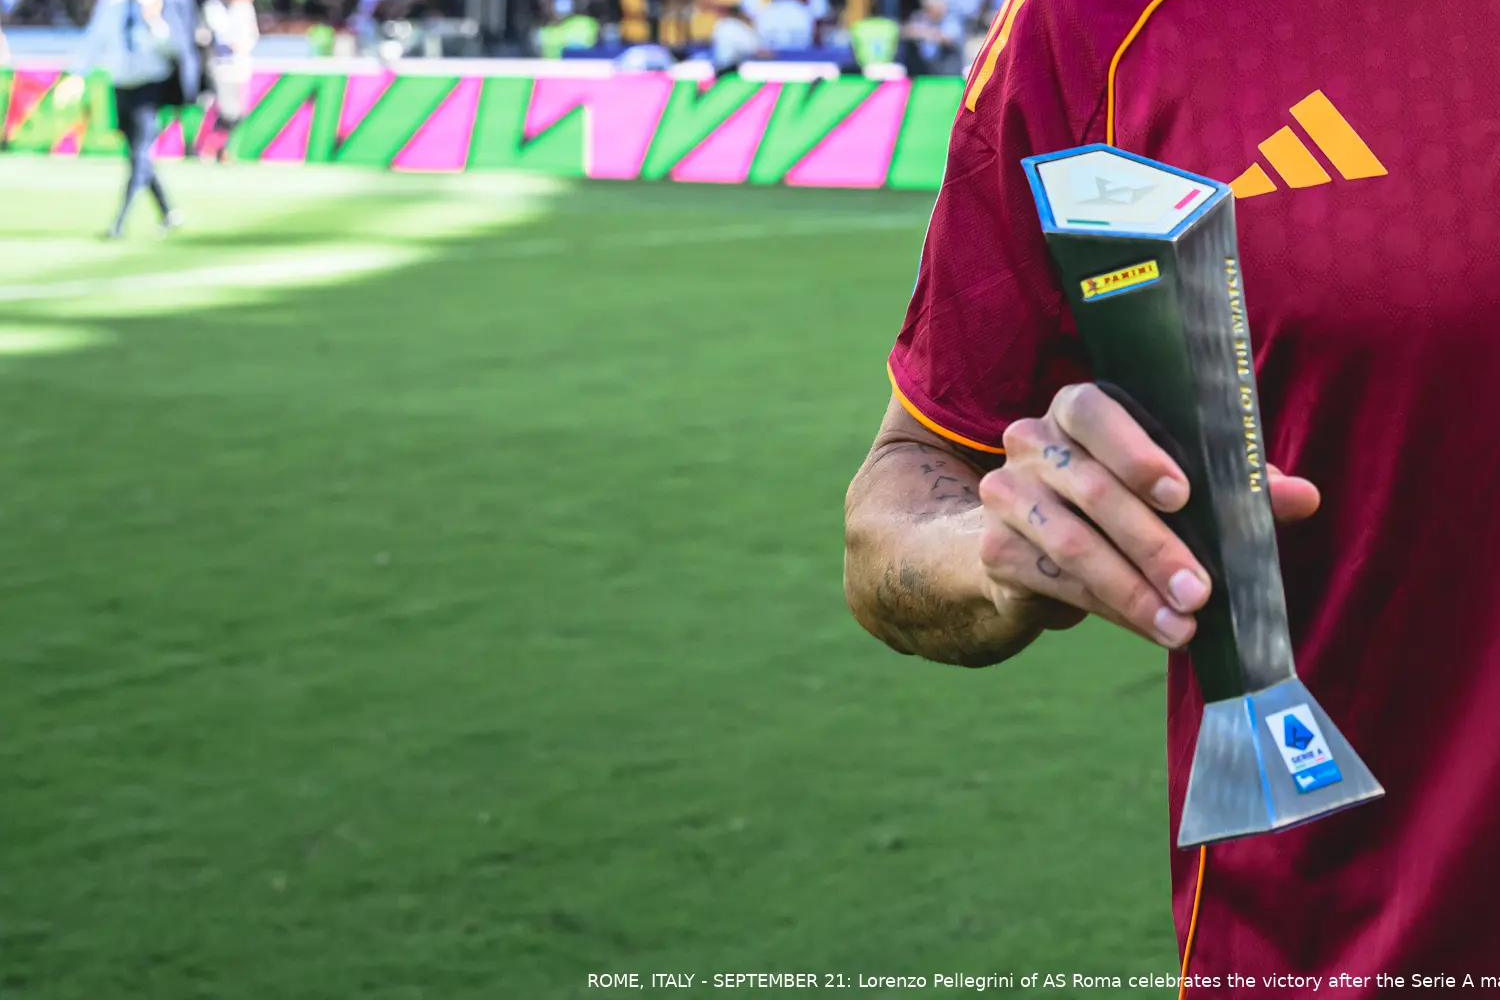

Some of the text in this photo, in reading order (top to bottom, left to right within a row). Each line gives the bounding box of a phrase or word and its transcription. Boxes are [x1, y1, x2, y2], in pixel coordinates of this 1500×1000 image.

[1104, 264, 1153, 284] PANINI
[1225, 257, 1244, 334] MATCH
[1235, 340, 1249, 375] THE
[1243, 415, 1262, 492] PLAYER
